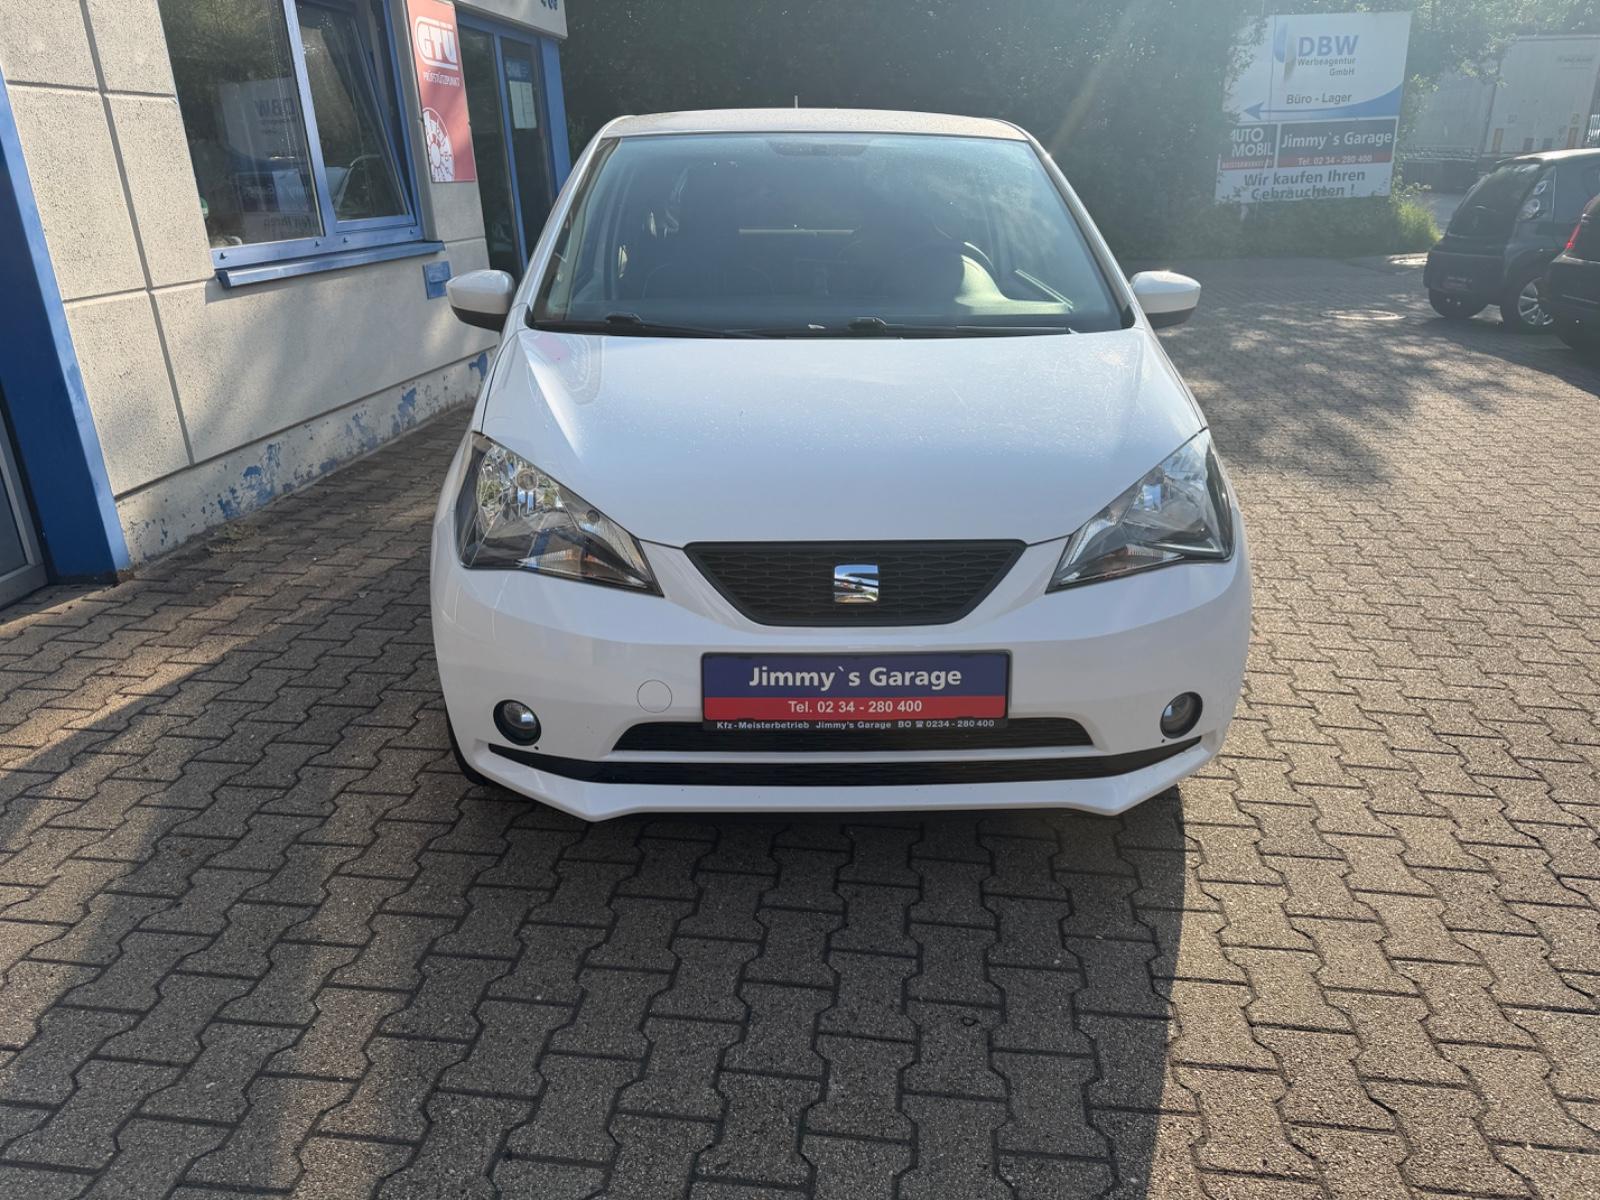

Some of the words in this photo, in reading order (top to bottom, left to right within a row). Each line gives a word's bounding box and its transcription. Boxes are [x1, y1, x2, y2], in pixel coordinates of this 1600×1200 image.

[417, 22, 458, 64] GTÜ
[1297, 35, 1360, 57] DBW
[1297, 57, 1357, 67] Werbeagentur
[1328, 68, 1356, 76] GmbH
[1286, 94, 1312, 105] Büro
[1321, 92, 1352, 105] Lager
[1344, 131, 1393, 147] Garage
[1232, 142, 1273, 157] MOBIL
[1297, 157, 1312, 166] Tel.
[1244, 172, 1269, 186] Wir
[1272, 170, 1323, 185] kaufen
[1327, 169, 1366, 183] Ihren
[869, 667, 962, 690] Garage
[787, 701, 813, 713] Tel.
[817, 701, 833, 713] 02
[838, 701, 855, 713] 34
[868, 701, 893, 713] 280
[897, 700, 923, 712] 400
[716, 721, 810, 730] Kfz-Meisterbetrieb
[815, 721, 854, 730] Jimmy's
[857, 721, 892, 730] Garage
[897, 720, 912, 728] BO
[925, 720, 949, 728] 0234
[957, 720, 975, 728] 280
[976, 719, 995, 728] 400
